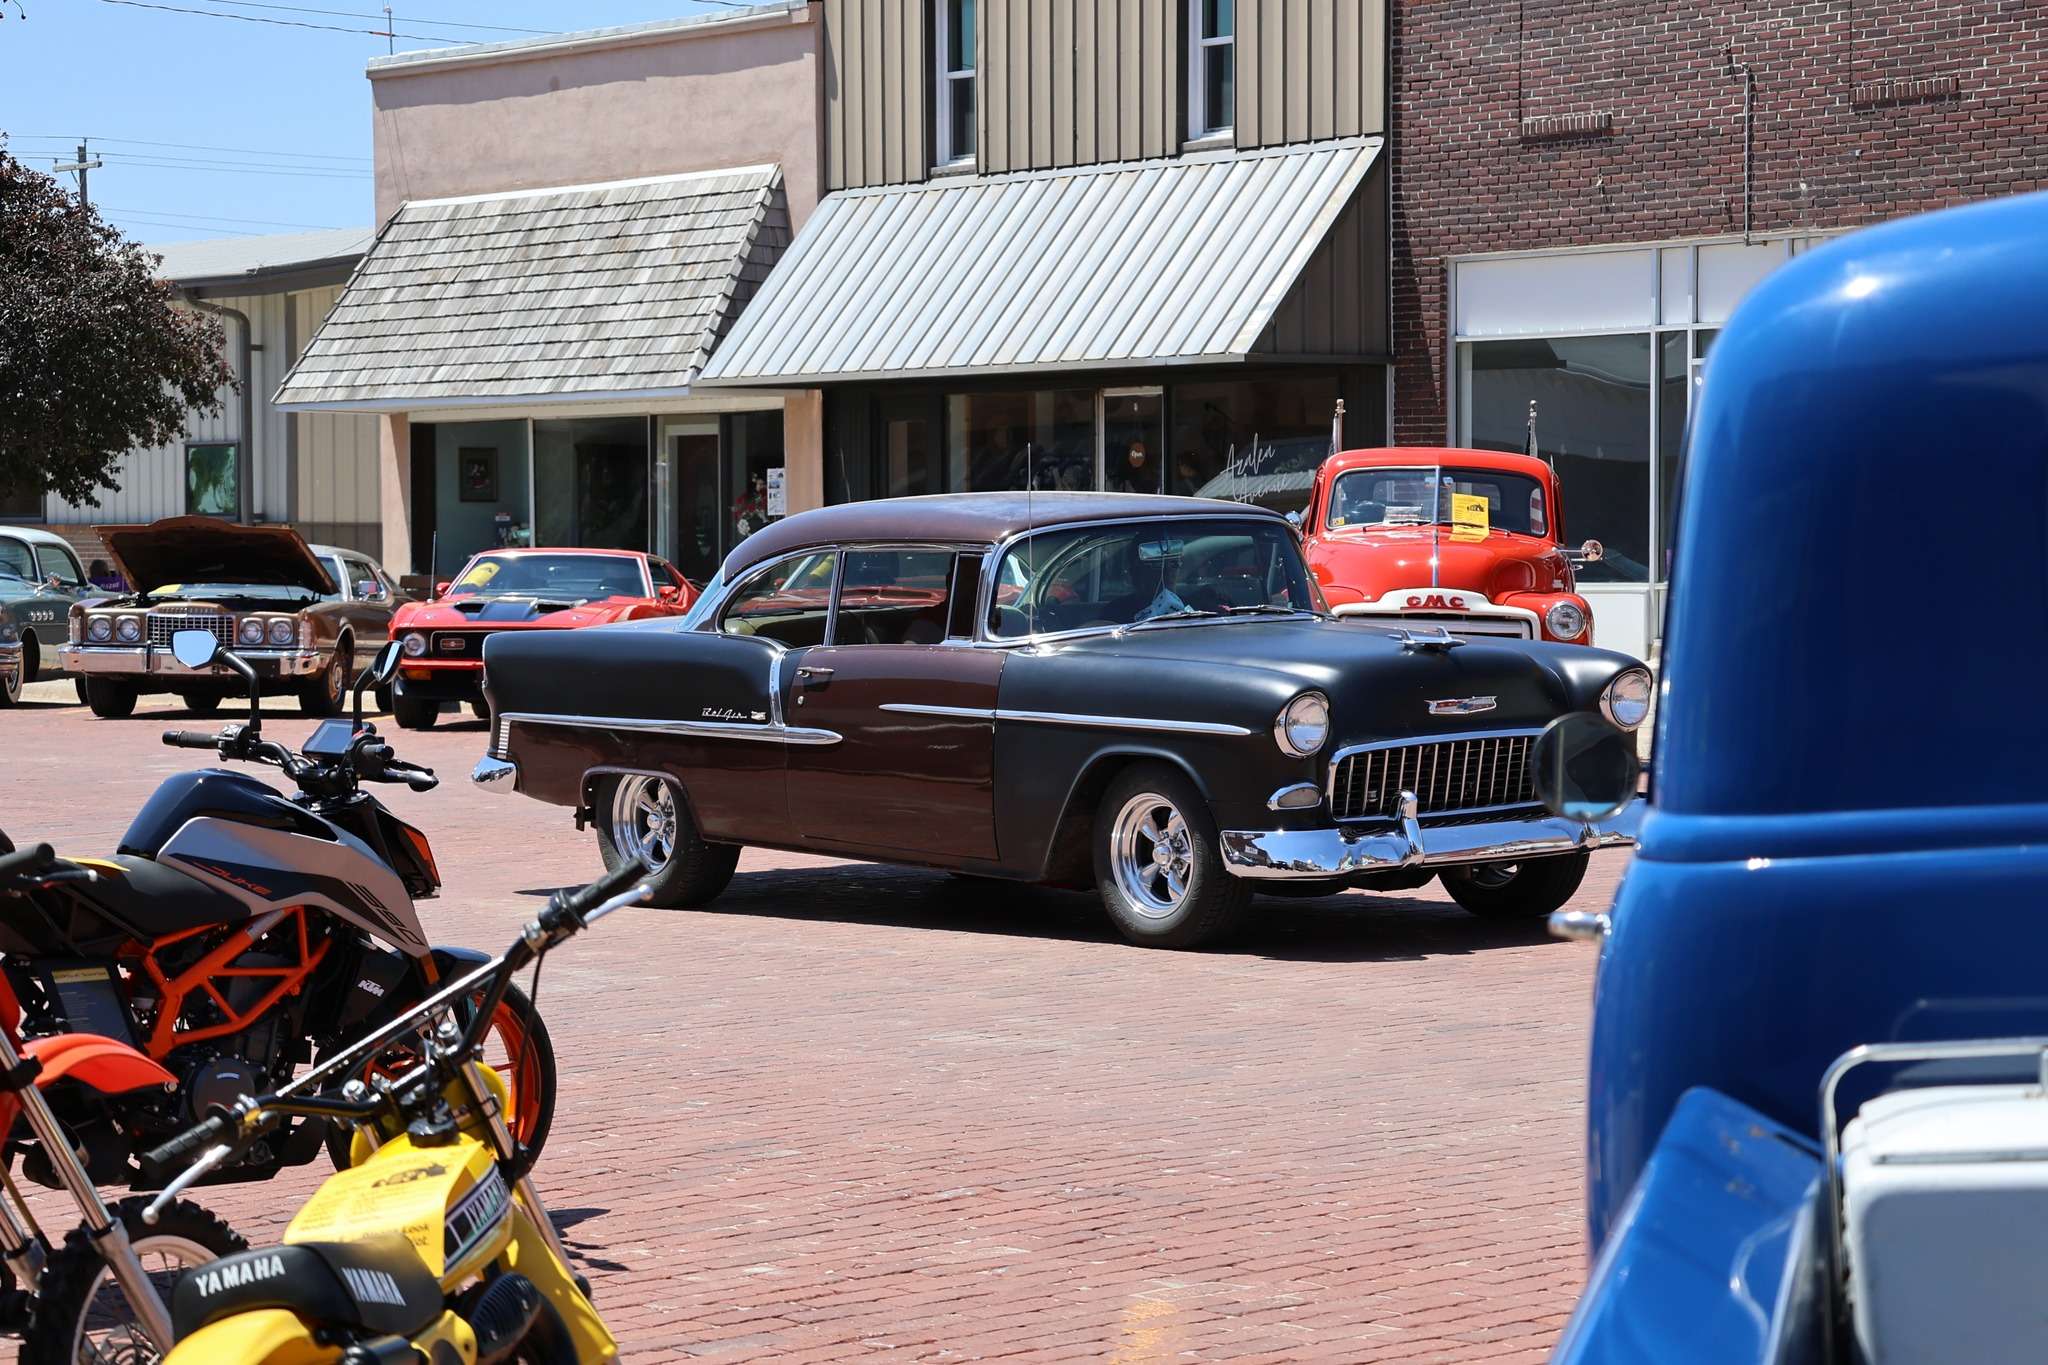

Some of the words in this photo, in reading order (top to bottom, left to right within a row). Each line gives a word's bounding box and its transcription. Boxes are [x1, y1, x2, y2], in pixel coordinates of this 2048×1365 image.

[1406, 594, 1465, 607] GMC
[358, 979, 385, 997] KTM
[195, 1254, 285, 1297] YAMAHA
[341, 1267, 407, 1307] YAMAHA
